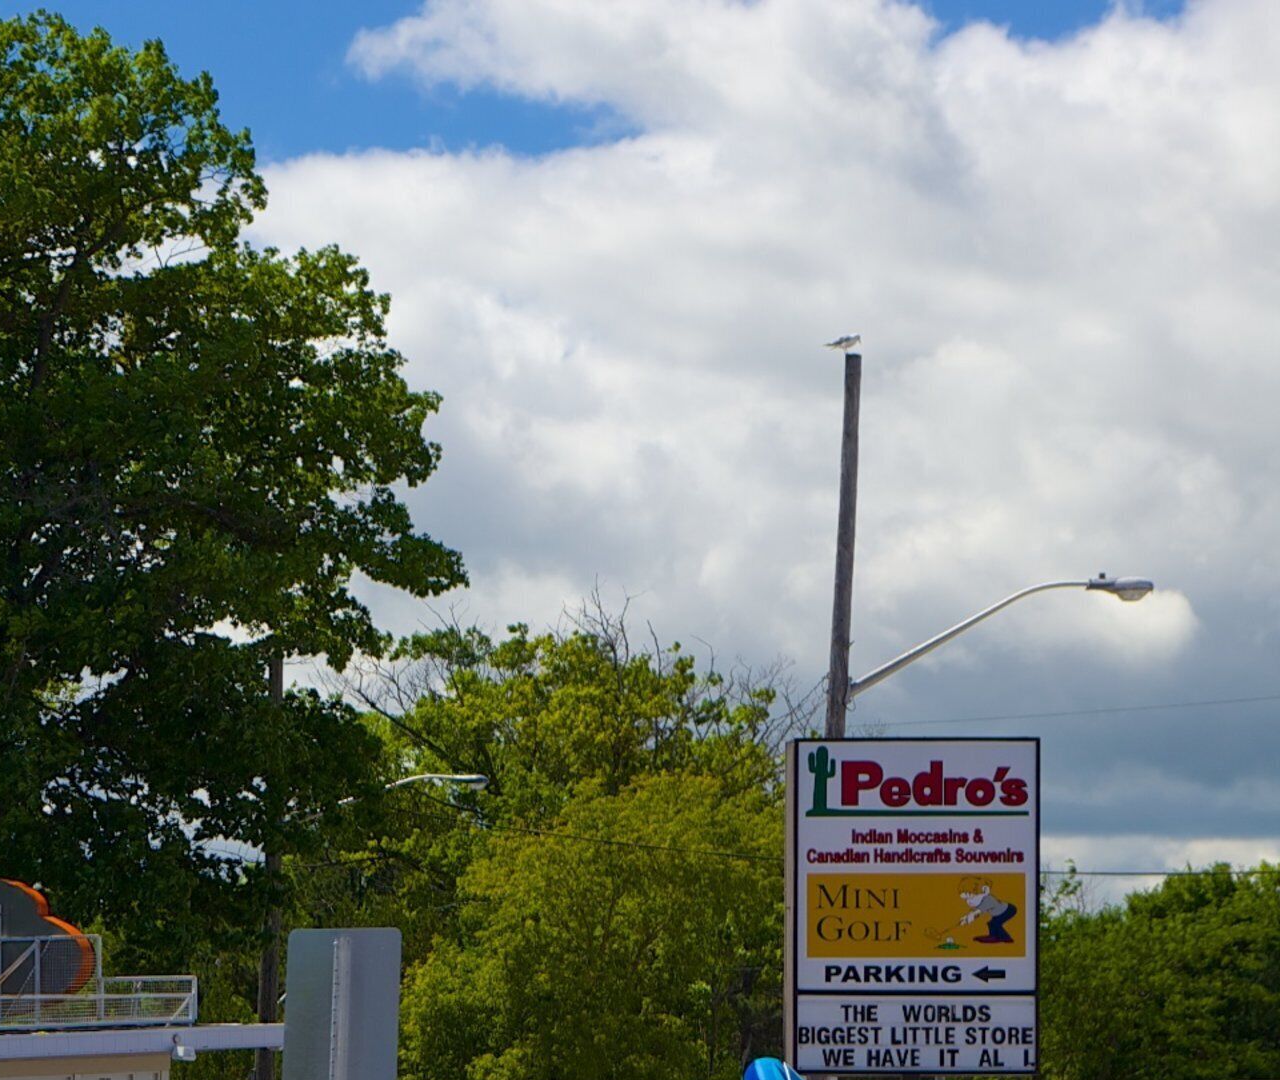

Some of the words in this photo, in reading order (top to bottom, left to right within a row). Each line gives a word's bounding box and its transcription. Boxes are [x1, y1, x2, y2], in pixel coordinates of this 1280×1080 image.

[841, 760, 1029, 807] Pedro's
[851, 828, 893, 844] Indian
[897, 829, 969, 844] Moccasins
[973, 829, 983, 844] &
[806, 849, 870, 864] Canadian
[873, 849, 951, 864] Handicrafts
[955, 849, 1024, 864] Souvenirs
[816, 883, 900, 909] MINI
[816, 915, 912, 943] GOLF
[824, 965, 962, 983] PARKING
[841, 1004, 878, 1023] THE
[902, 1004, 991, 1023] WORLDS
[798, 1026, 882, 1045] BIGGEST
[891, 1026, 956, 1045] LITTLE
[965, 1026, 1034, 1045] STORE
[822, 1049, 855, 1067] WE
[867, 1049, 920, 1067] HAVE
[939, 1049, 959, 1067] IT
